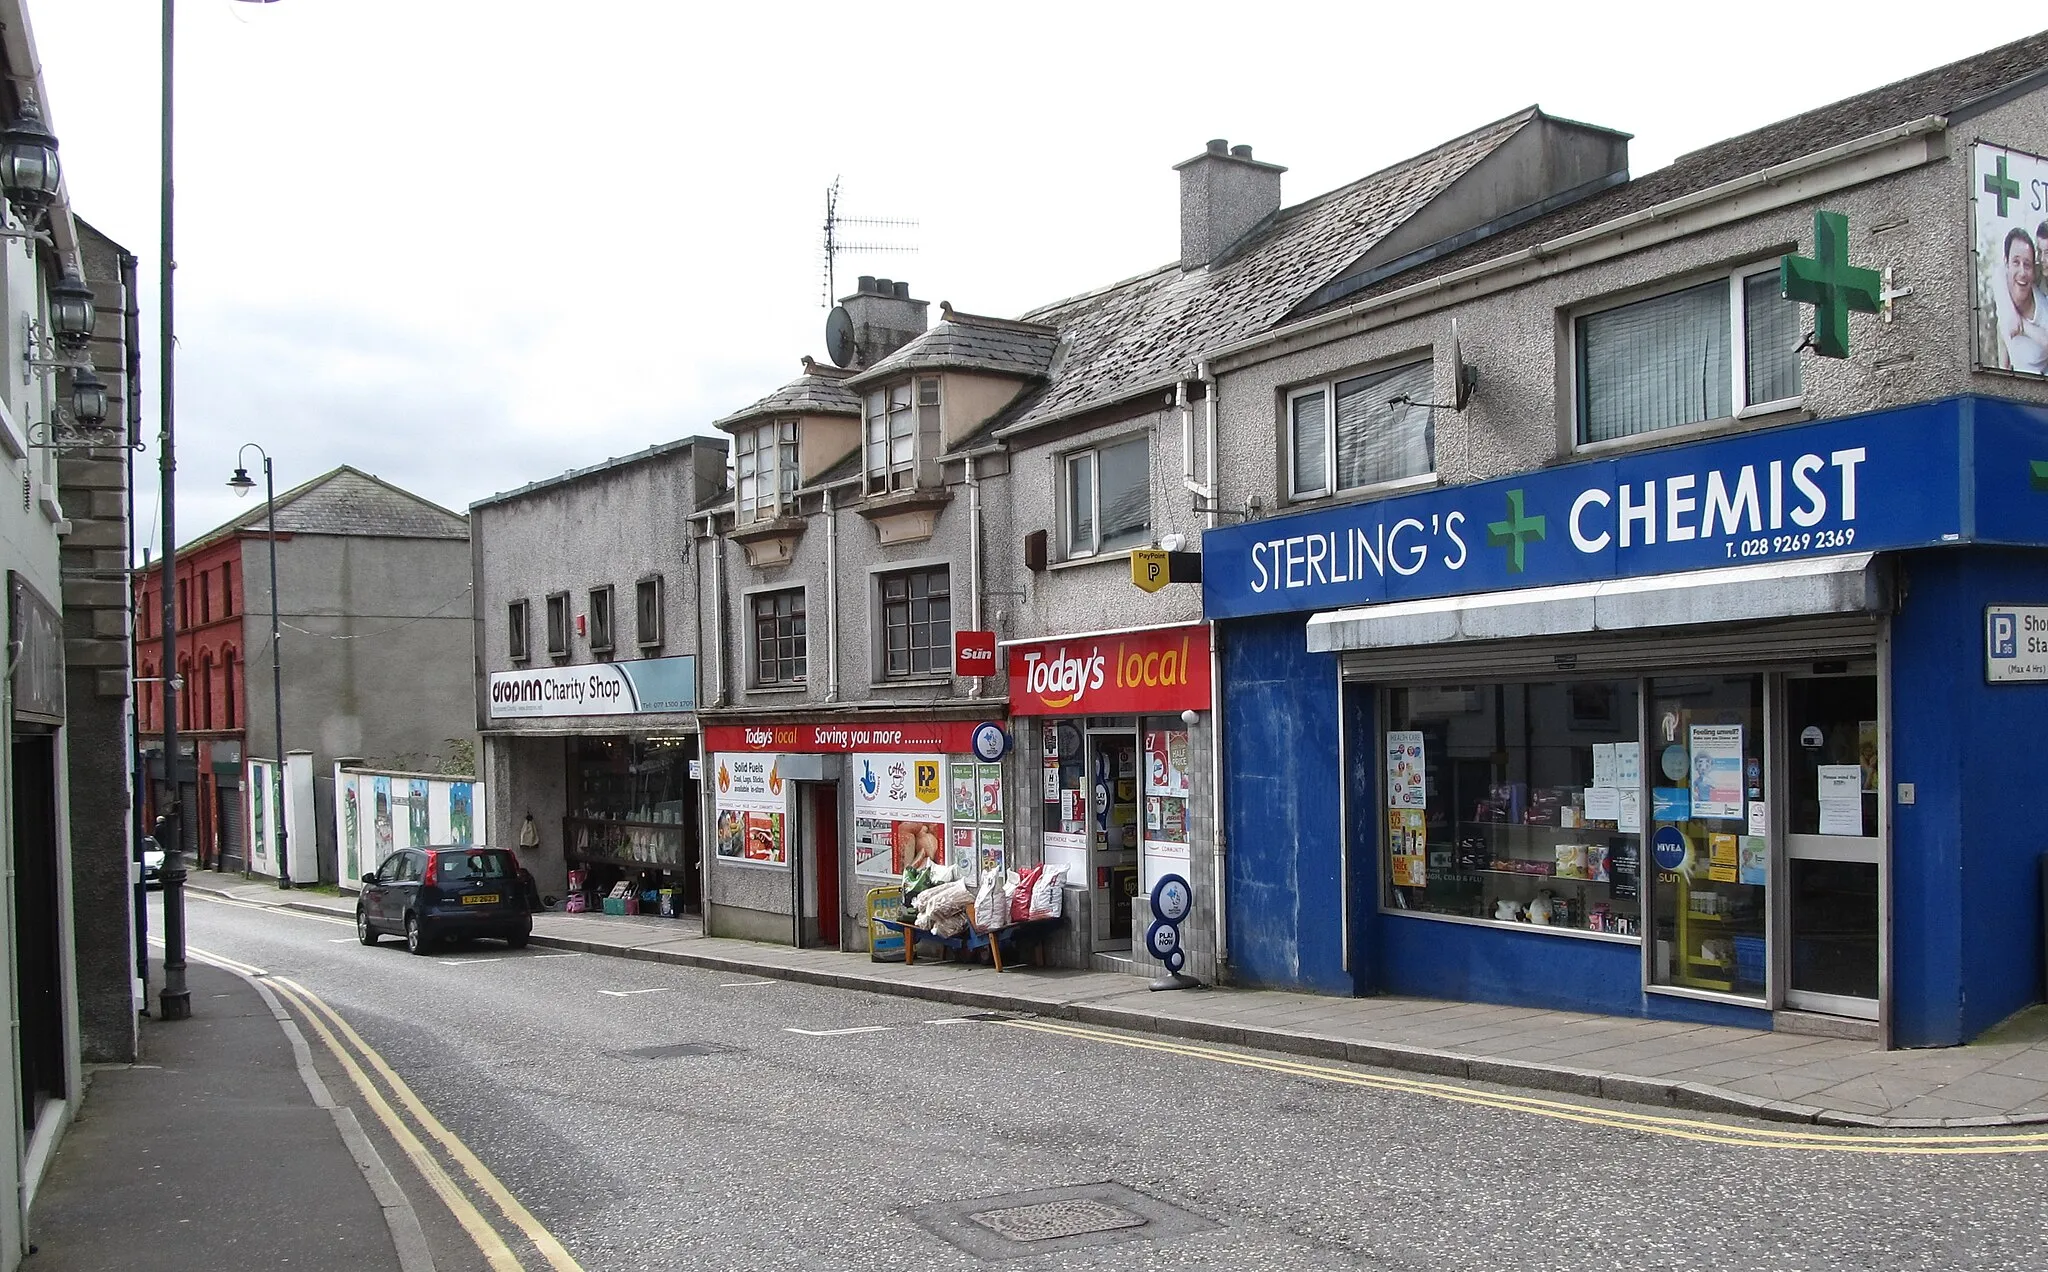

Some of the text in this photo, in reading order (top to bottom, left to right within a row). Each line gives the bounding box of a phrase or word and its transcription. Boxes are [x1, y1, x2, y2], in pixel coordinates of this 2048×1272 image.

[1250, 447, 1866, 593] STERLING'S CHEMIST
[1725, 528, 1855, 558] T. 028 9269 2369
[1138, 552, 1166, 560] PayPoint
[2024, 615, 2048, 631] Sho
[2002, 643, 2013, 654] 36
[1024, 636, 1191, 702] Today's local
[2008, 664, 2046, 675] (Max 4 Hrs)
[544, 677, 586, 705] Charity
[589, 675, 621, 704] Shop
[745, 727, 773, 748] Today's
[775, 727, 797, 744] local
[814, 726, 848, 749] Saving
[850, 730, 870, 748] you
[873, 730, 902, 745] more
[1172, 749, 1186, 758] HALF
[733, 761, 764, 773] Solid Fuels
[1172, 758, 1187, 766] PRICE
[1656, 843, 1683, 852] NIVEA
[1658, 872, 1681, 883] sun
